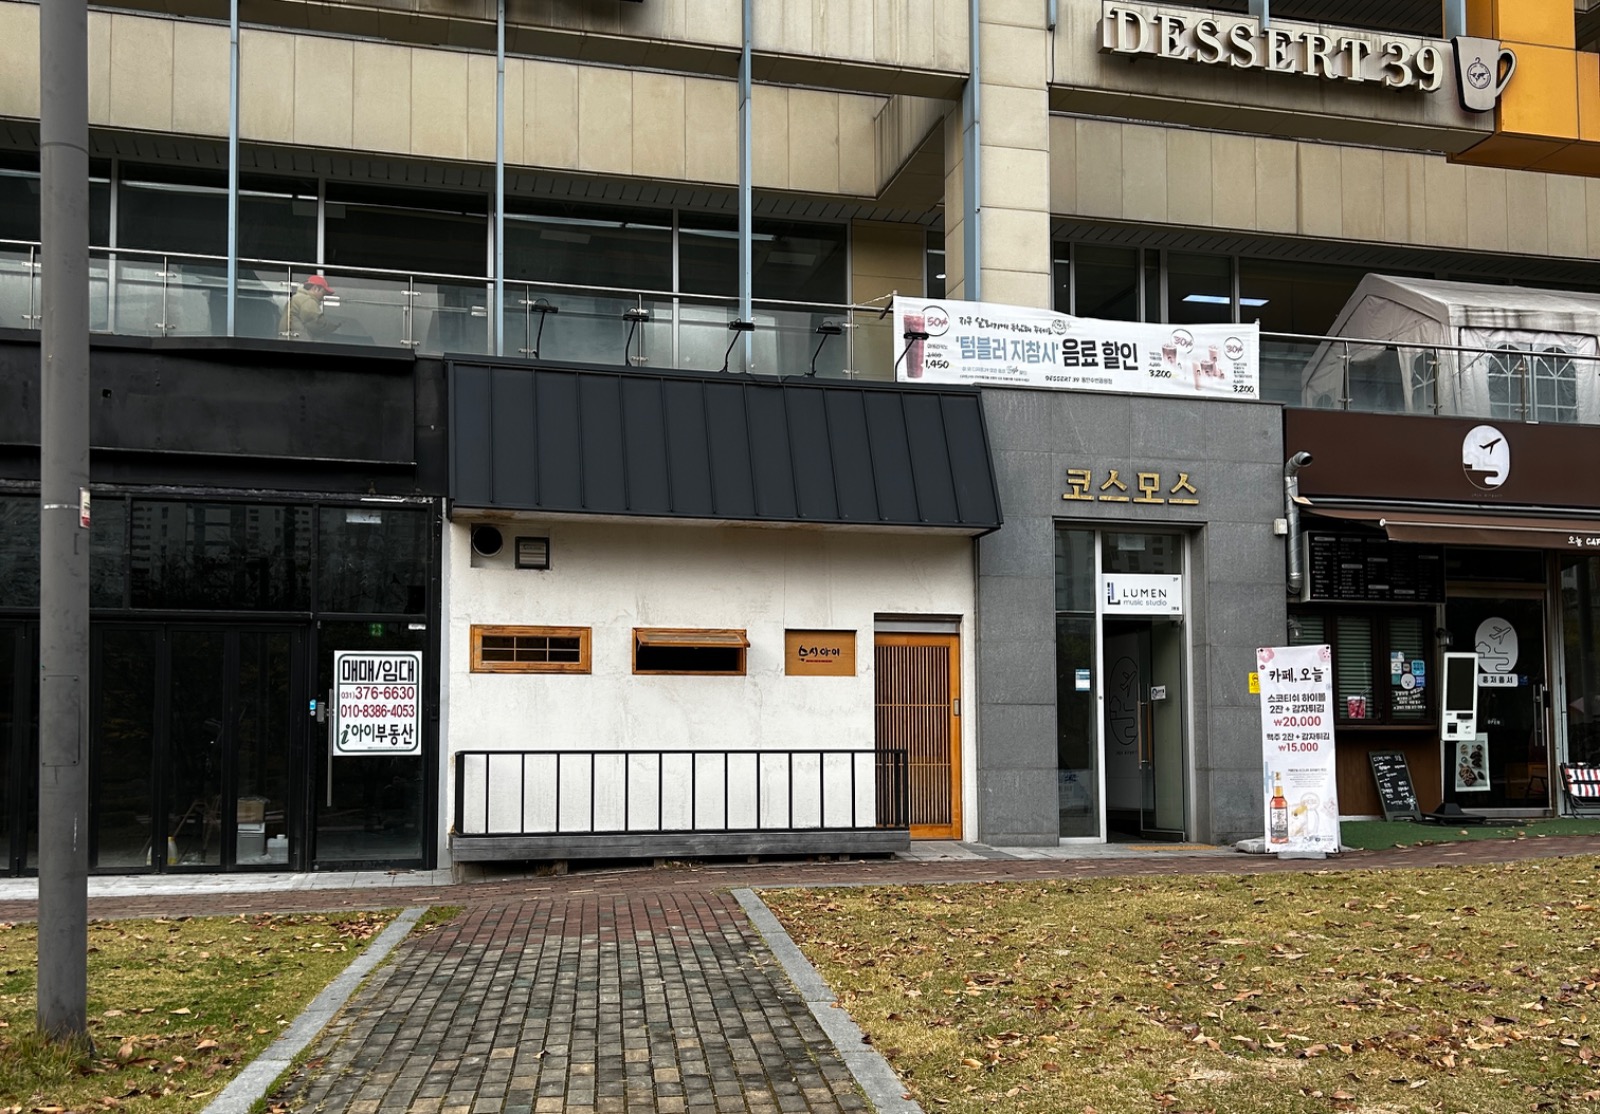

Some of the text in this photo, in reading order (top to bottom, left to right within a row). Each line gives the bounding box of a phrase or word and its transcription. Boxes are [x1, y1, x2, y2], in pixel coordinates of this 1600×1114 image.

[1105, 6, 1370, 82] DESSERT
[1384, 40, 1444, 93] 39
[1173, 336, 1193, 348] 30%
[955, 335, 1139, 371] '텀블러 지참시' 음료 할인
[1225, 345, 1242, 354] 30%
[925, 359, 949, 369] 1,450
[1148, 369, 1172, 379] 3,200
[1232, 384, 1255, 393] 3,200
[1062, 468, 1200, 506] 코스모스
[1567, 535, 1583, 547] 오늘
[1123, 588, 1167, 598] LUMEN
[342, 659, 415, 682] 매매/임대
[1269, 666, 1324, 683] 카페, 오늘
[1267, 692, 1326, 703] 스코티쉬 하이볼
[340, 704, 415, 718] 010-8386-4053
[1269, 705, 1284, 714] 2잔
[1292, 703, 1325, 714] 감자튀김
[1266, 733, 1280, 741] 맥주
[1282, 732, 1295, 741] 2잔
[1301, 732, 1330, 741] 감자튀김
